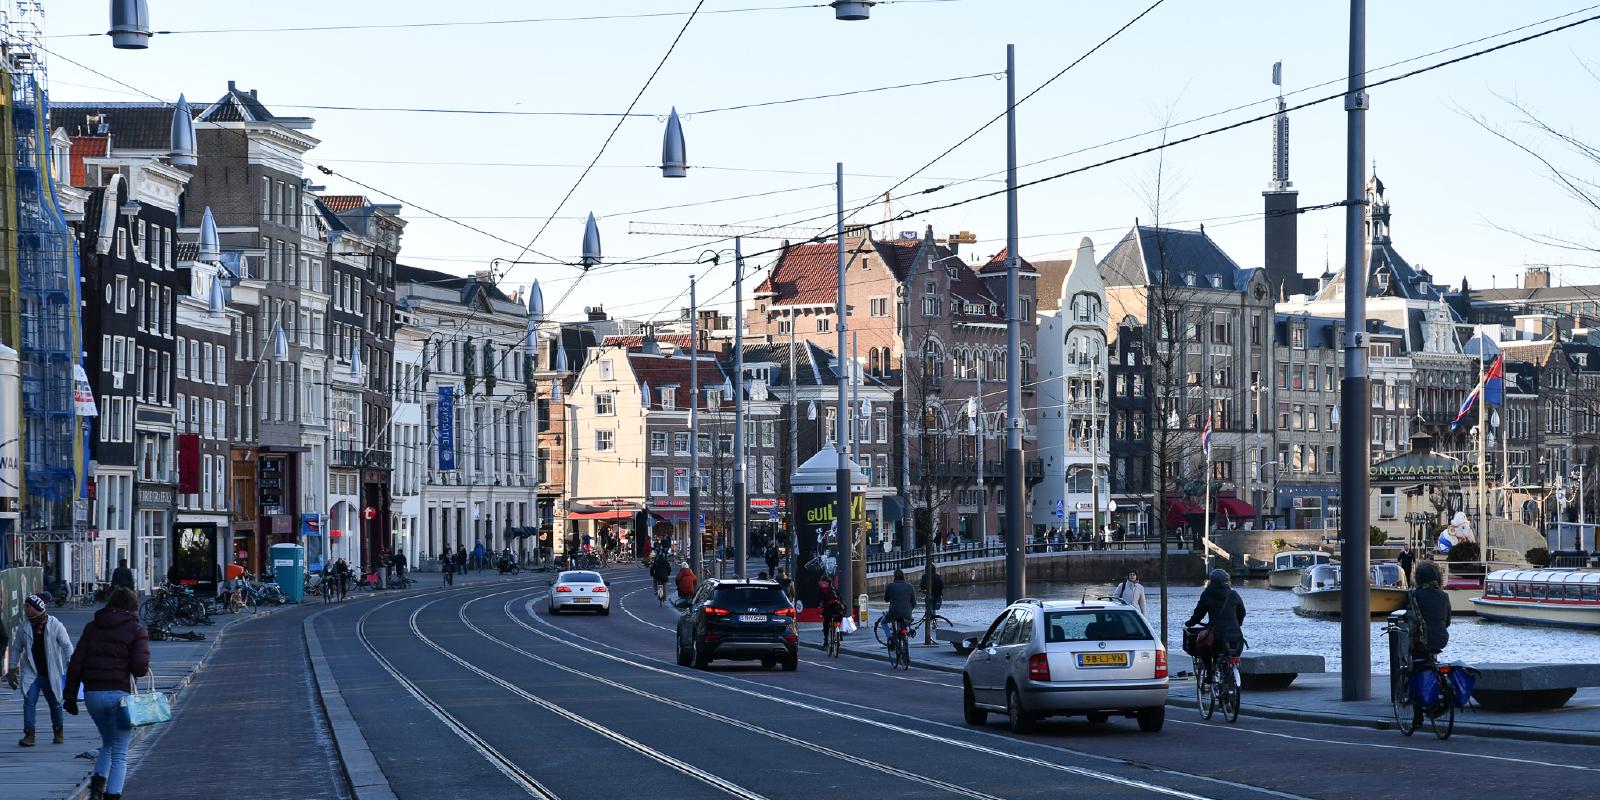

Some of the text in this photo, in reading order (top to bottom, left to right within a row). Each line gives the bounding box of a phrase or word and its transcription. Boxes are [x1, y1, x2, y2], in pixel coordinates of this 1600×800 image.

[442, 401, 450, 445] EXPOSITIE
[1370, 465, 1492, 475] ONDVAART KOOJ
[807, 495, 863, 522] GUILY!
[1086, 655, 1123, 663] 98-LJ-VN
